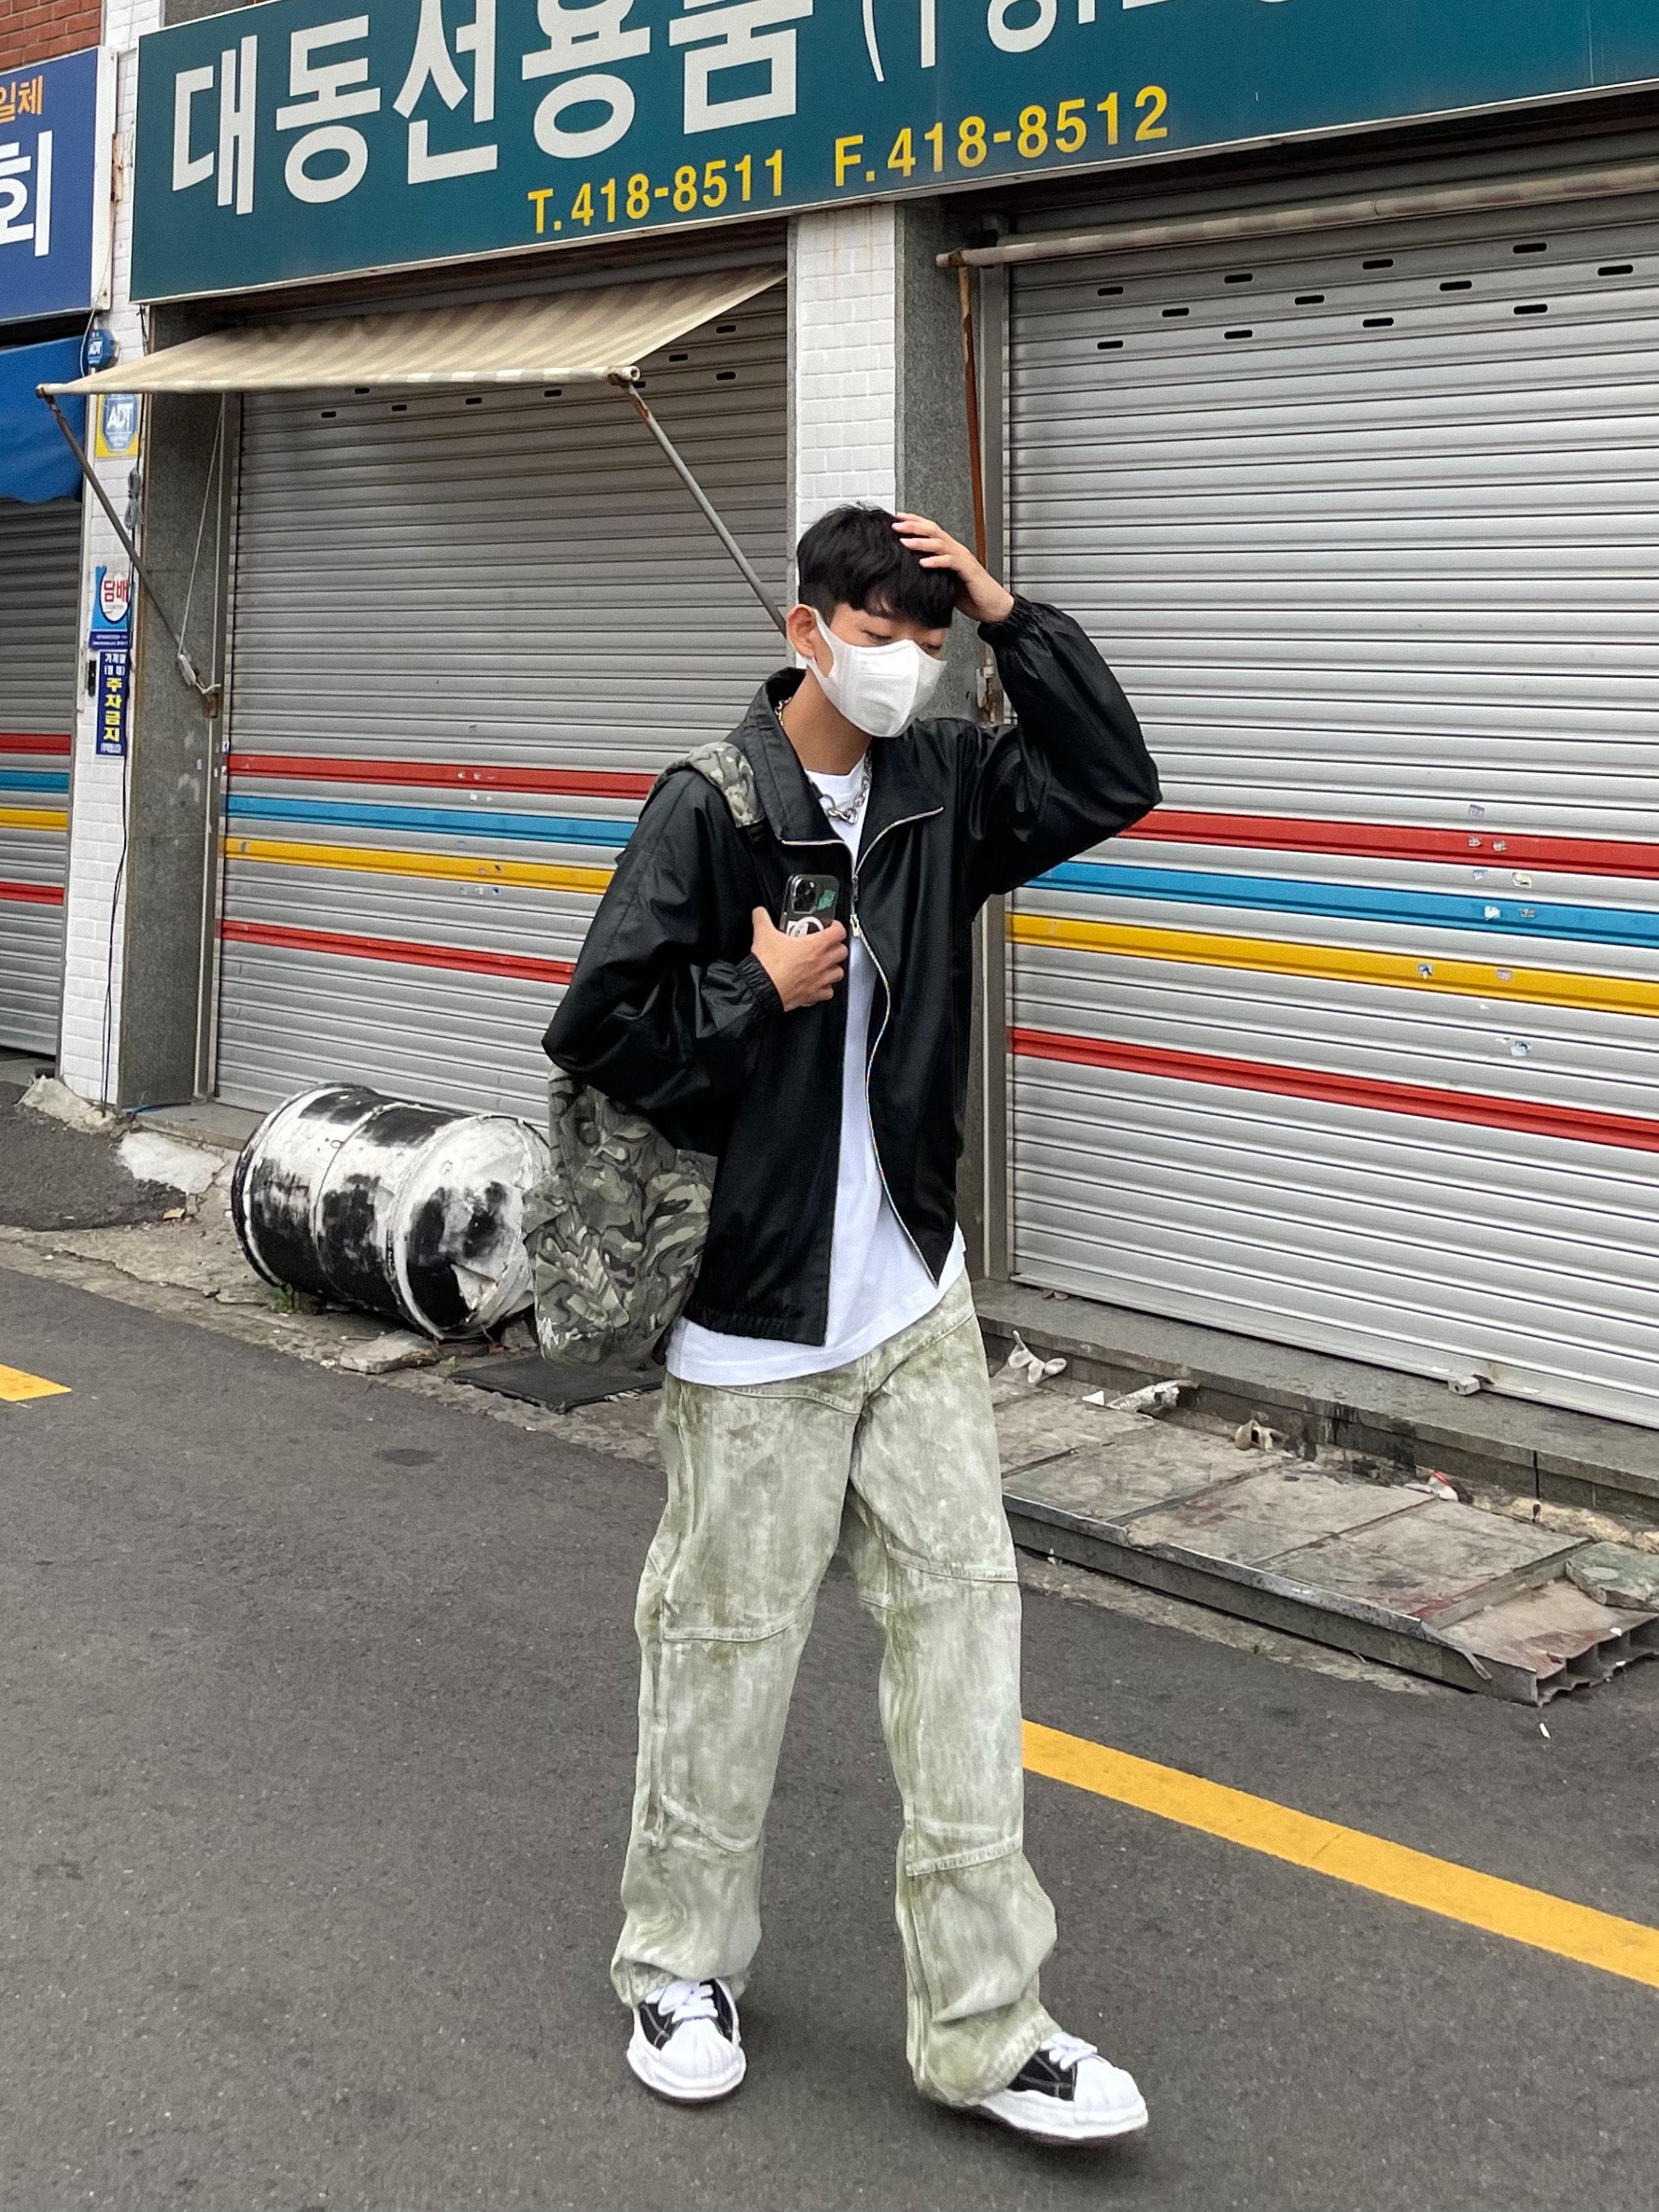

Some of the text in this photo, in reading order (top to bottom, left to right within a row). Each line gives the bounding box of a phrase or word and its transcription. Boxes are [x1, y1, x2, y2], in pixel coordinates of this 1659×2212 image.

[173, 0, 813, 215] 대동선용품
[527, 85, 1169, 234] T.418-8511 F.418-8512
[106, 402, 134, 430] ADT
[104, 580, 129, 603] 담배
